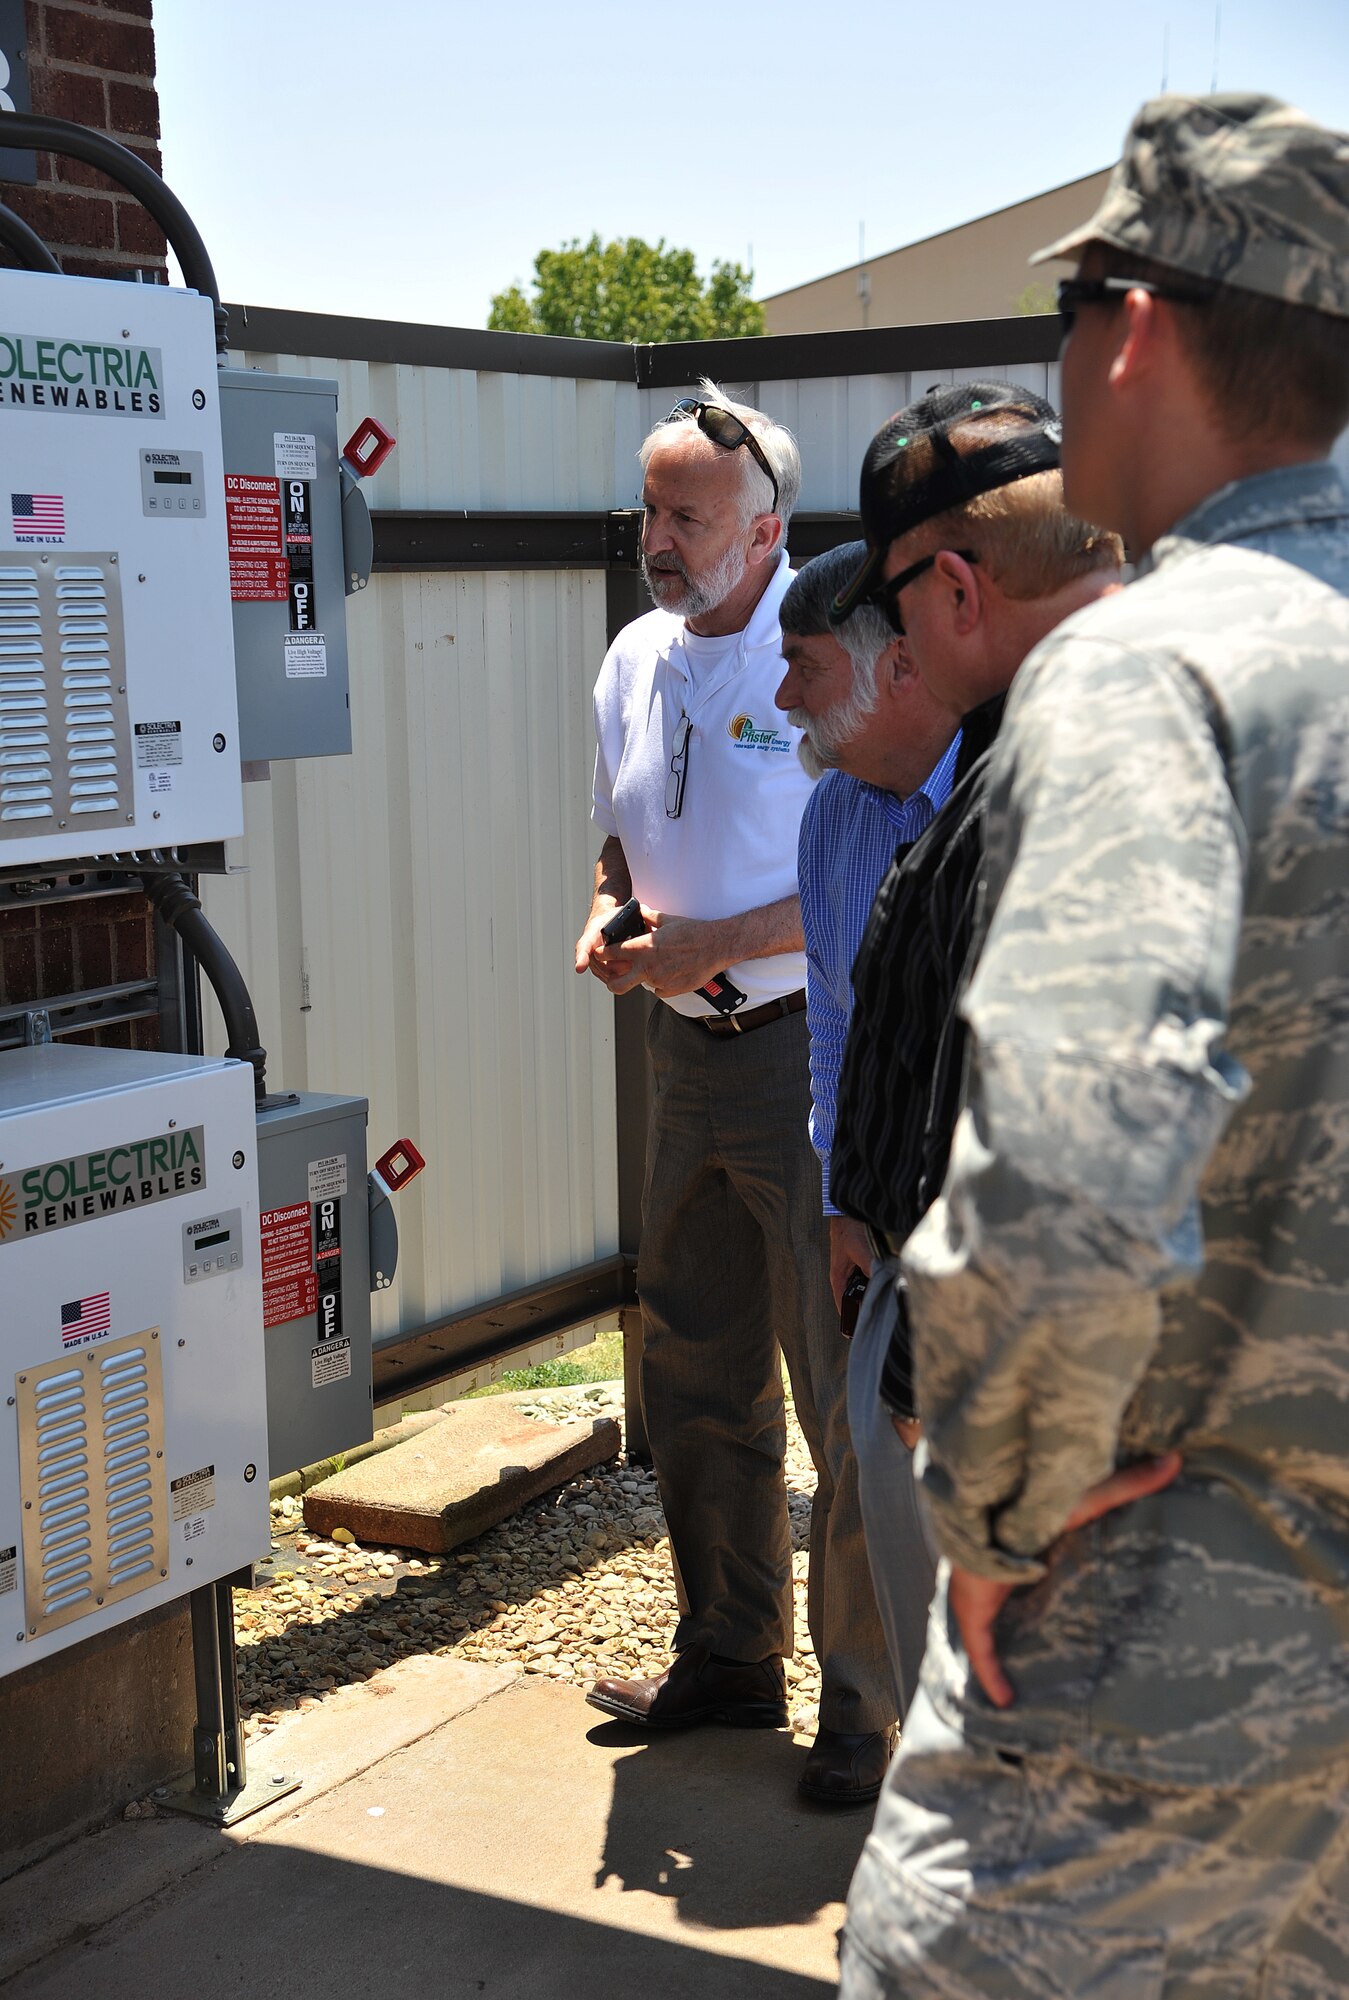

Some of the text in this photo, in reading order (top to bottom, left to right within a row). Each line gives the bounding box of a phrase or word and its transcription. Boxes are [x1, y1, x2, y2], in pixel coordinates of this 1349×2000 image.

[151, 453, 180, 461] SOLECTRIA
[227, 477, 276, 491] DC Disconnect
[290, 481, 305, 513] ON
[16, 535, 34, 543] MADE
[294, 583, 308, 629] OFF
[291, 636, 318, 645] DANGER
[147, 722, 177, 731] SOLECTRIA
[740, 731, 791, 747] Pfister Energy
[22, 1131, 200, 1210] SOLECTRIA
[25, 1167, 201, 1232] RENEWABLES
[262, 1205, 308, 1226] DC Disconnect
[321, 1201, 334, 1231] ON
[193, 1219, 219, 1230] SOLECTRIA
[322, 1248, 340, 1258] DANGER
[323, 1294, 335, 1338] OFF
[64, 1338, 81, 1349] MADE
[318, 1341, 343, 1355] DANGER
[182, 1467, 210, 1482] SOLECTRIA
